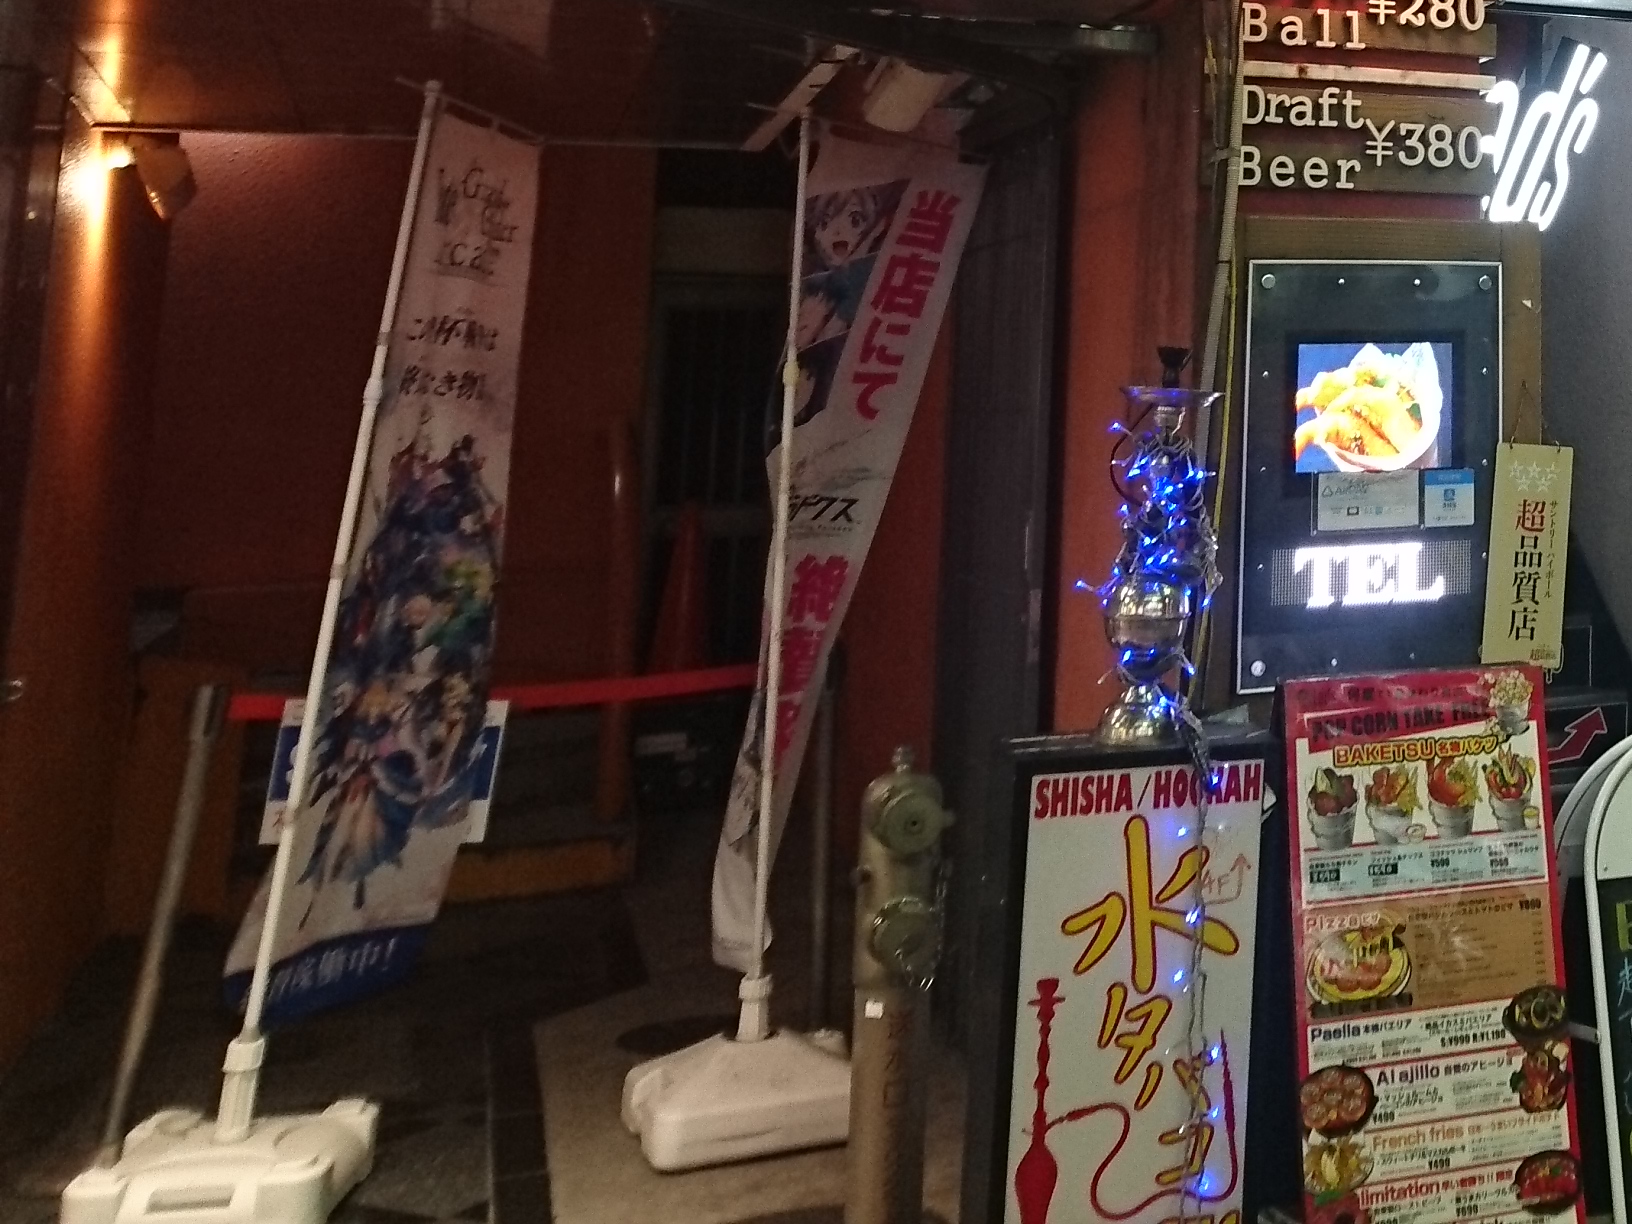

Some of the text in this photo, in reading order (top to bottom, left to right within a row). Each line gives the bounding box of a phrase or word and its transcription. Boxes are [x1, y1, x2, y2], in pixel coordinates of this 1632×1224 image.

[1241, 2, 1366, 50] Ball
[1242, 84, 1366, 129] Draft
[1239, 146, 1360, 189] Beer
[1366, 120, 1484, 169] ¥380
[851, 189, 962, 423] 当店にて
[1294, 541, 1444, 609] TEL
[1508, 498, 1547, 641] 超品質店
[1333, 738, 1435, 768] BAKETSU
